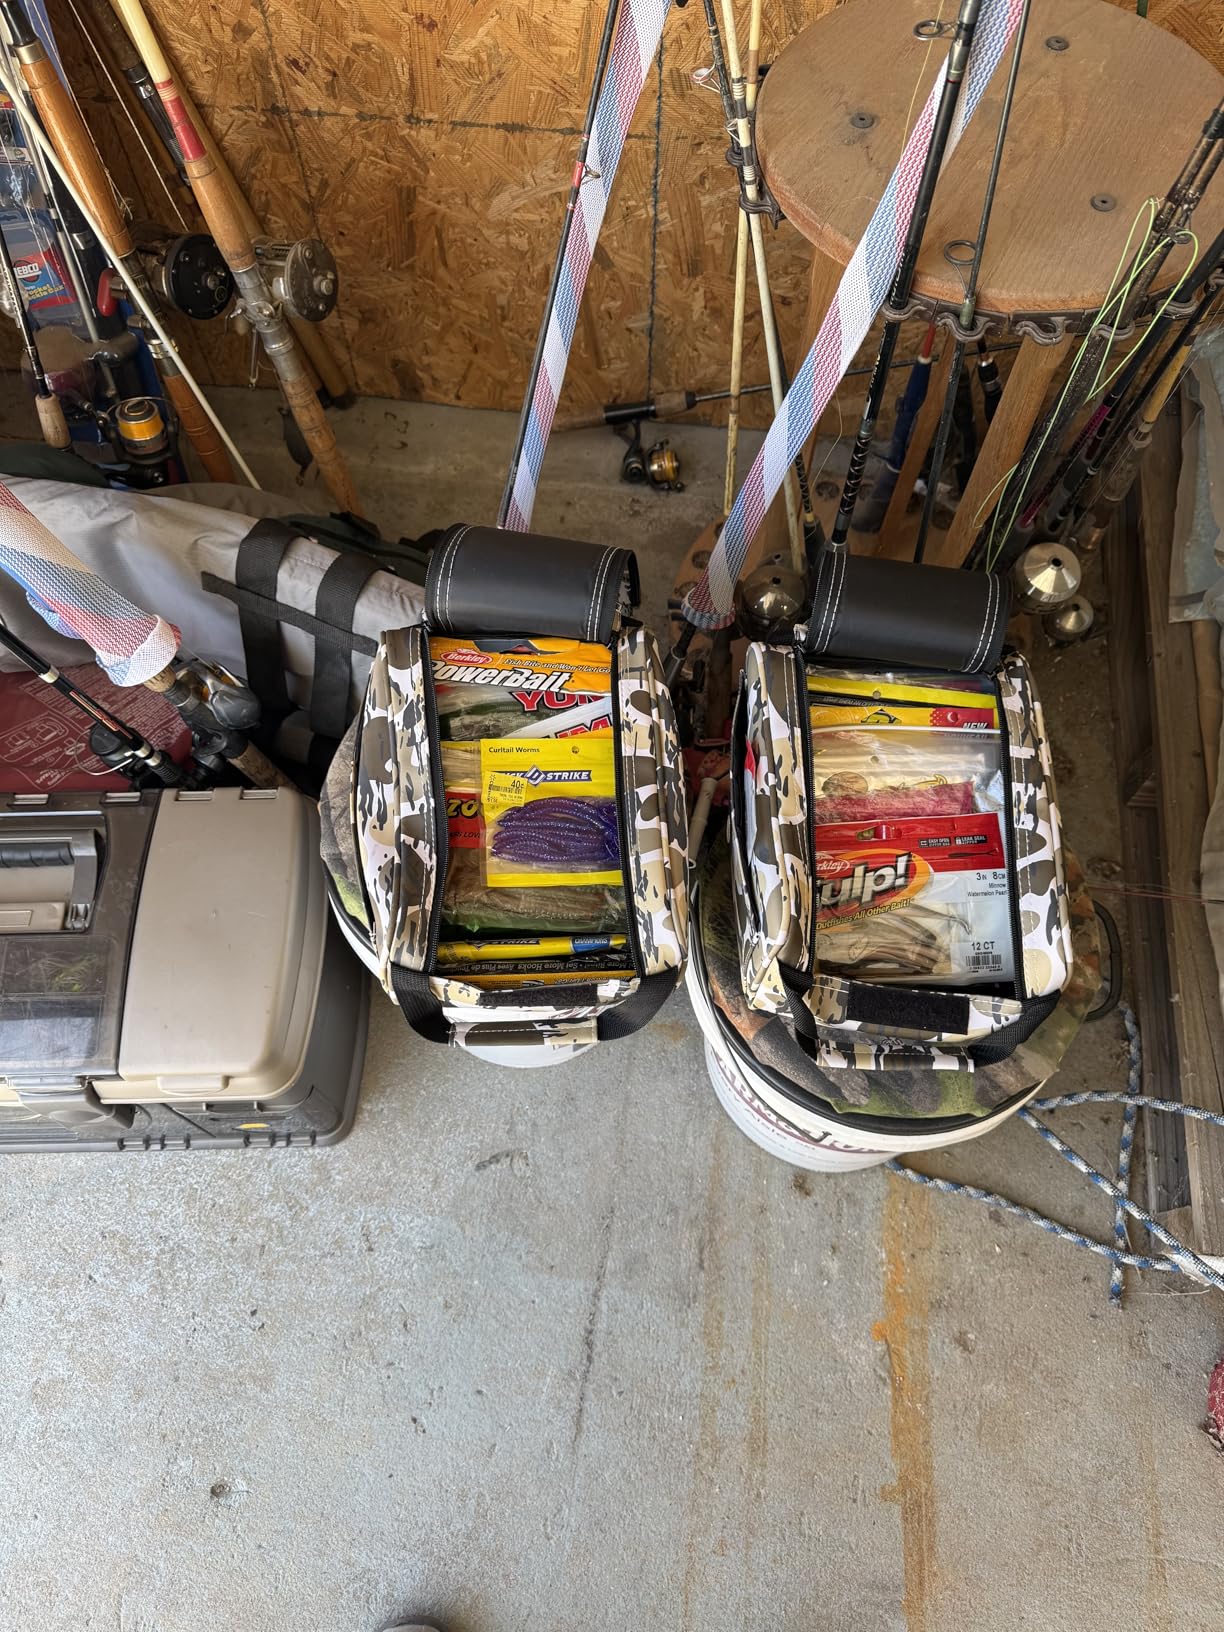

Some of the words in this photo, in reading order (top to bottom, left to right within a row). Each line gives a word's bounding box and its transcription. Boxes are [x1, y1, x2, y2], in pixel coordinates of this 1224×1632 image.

[13, 263, 40, 276] EBCO
[446, 653, 488, 664] Berkley
[488, 746, 514, 754] Curltail
[546, 771, 589, 781] STRIKE
[818, 853, 911, 905] ulp!
[853, 909, 865, 920] All
[866, 904, 890, 917] Other
[890, 898, 911, 911] Bait!
[971, 941, 981, 951] 12
[983, 941, 995, 950] CT
